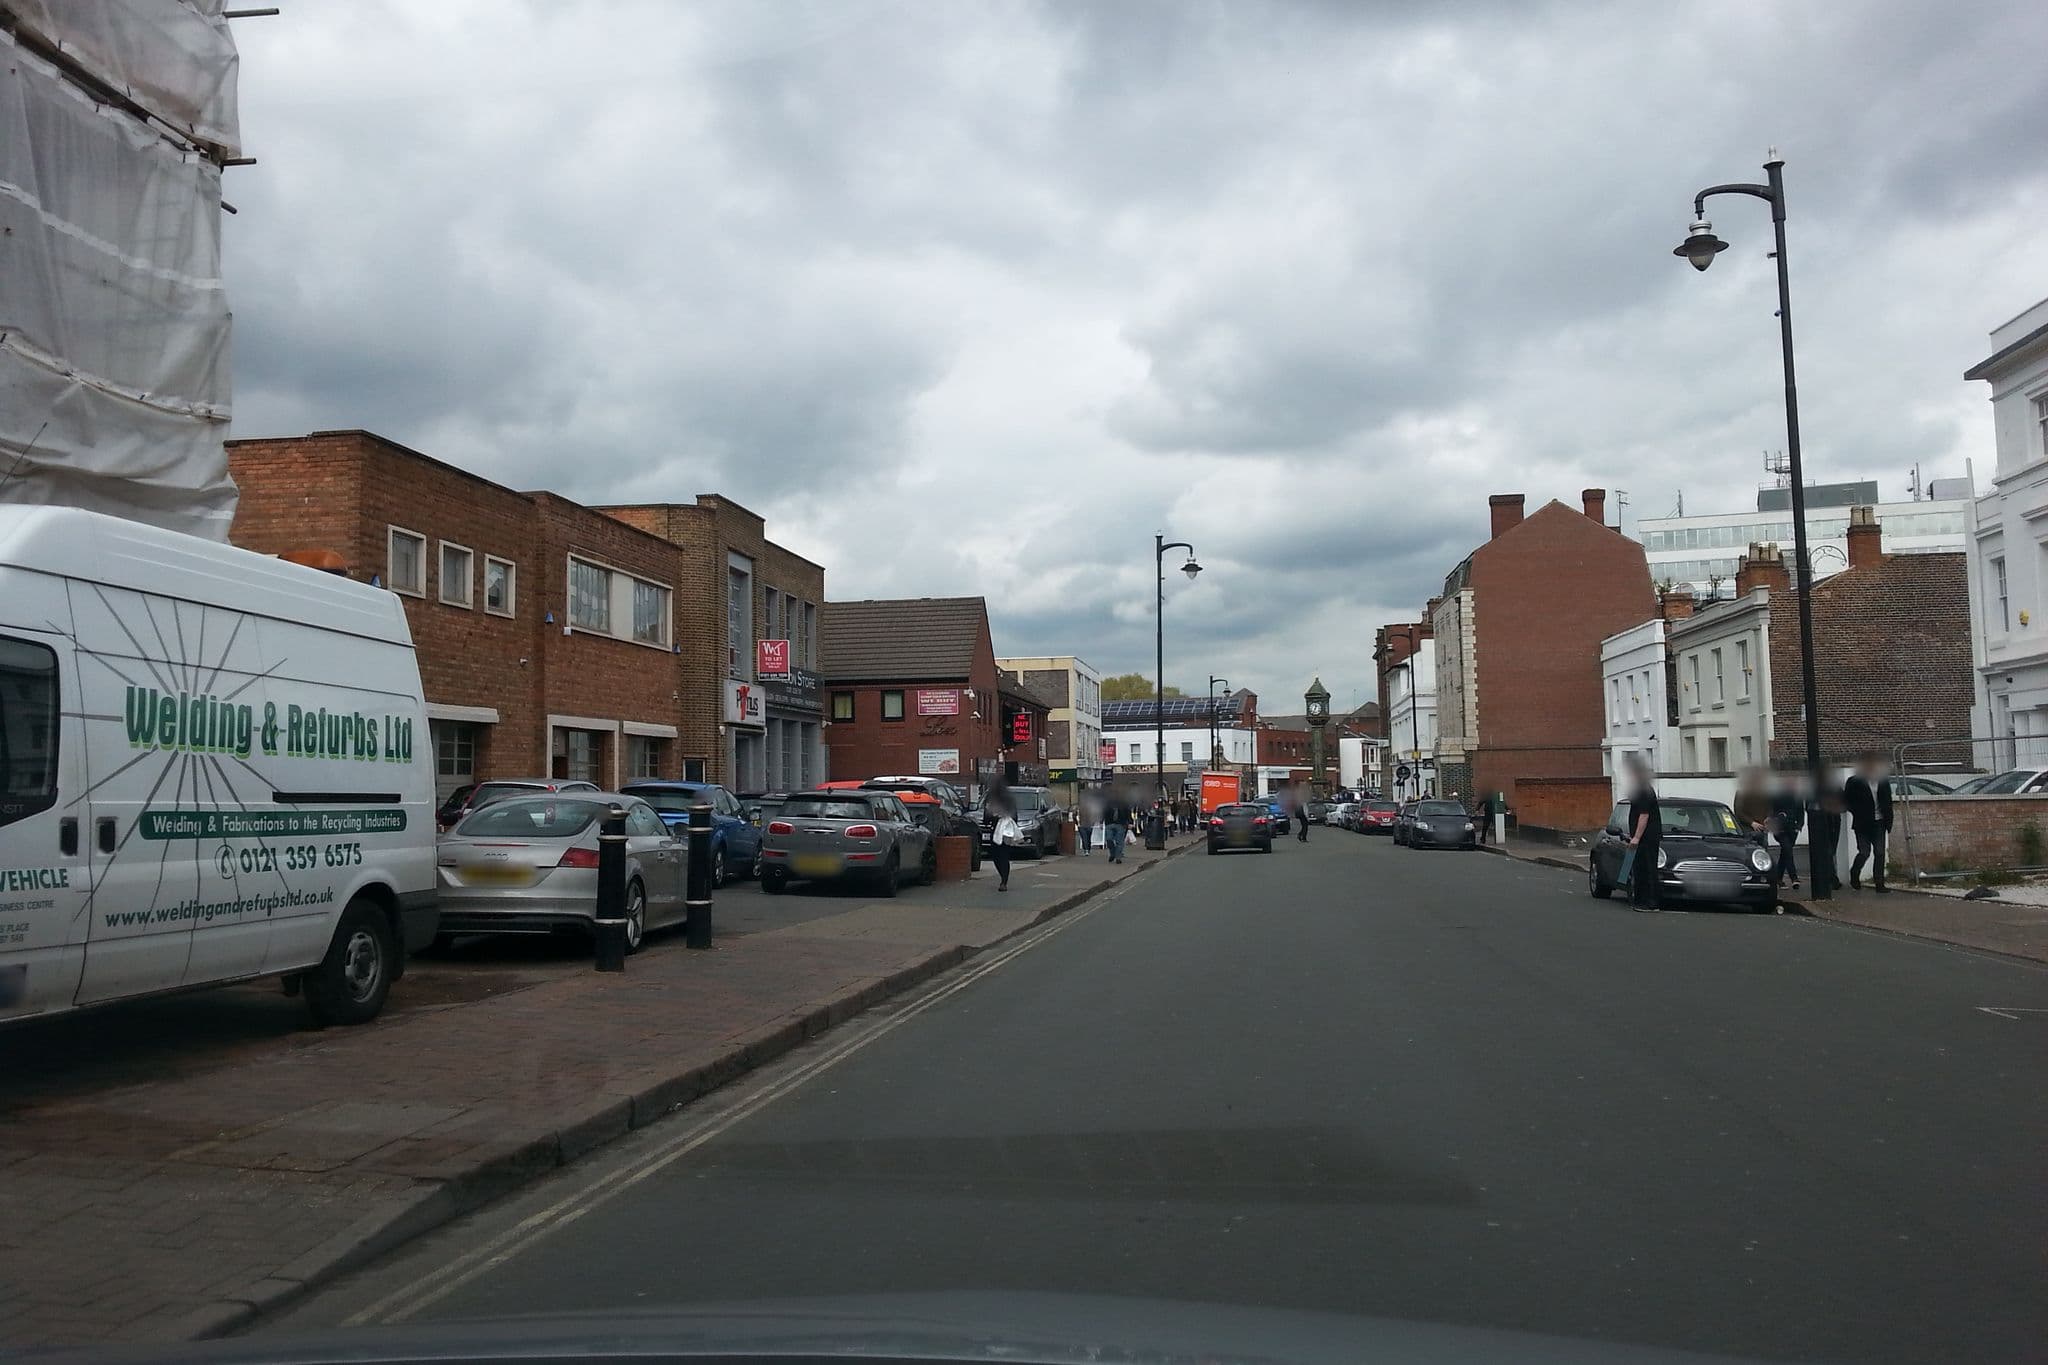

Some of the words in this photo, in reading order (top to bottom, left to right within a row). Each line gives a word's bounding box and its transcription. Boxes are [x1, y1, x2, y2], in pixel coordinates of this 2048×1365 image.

[126, 686, 252, 759] Welding
[261, 701, 279, 756] &
[287, 703, 378, 762] Refurbs
[384, 714, 412, 763] Ltd
[153, 815, 201, 835] Welding
[207, 816, 216, 832] &
[222, 815, 284, 832] Fabrications
[289, 817, 299, 830] to
[304, 815, 317, 830] the
[322, 814, 361, 831] Recycling
[365, 813, 400, 828] Industries
[240, 847, 278, 873] 0121
[285, 845, 316, 870] 359
[325, 842, 361, 867] 6575
[105, 886, 333, 928] www.weldingandrefurbsltd.co.uk
